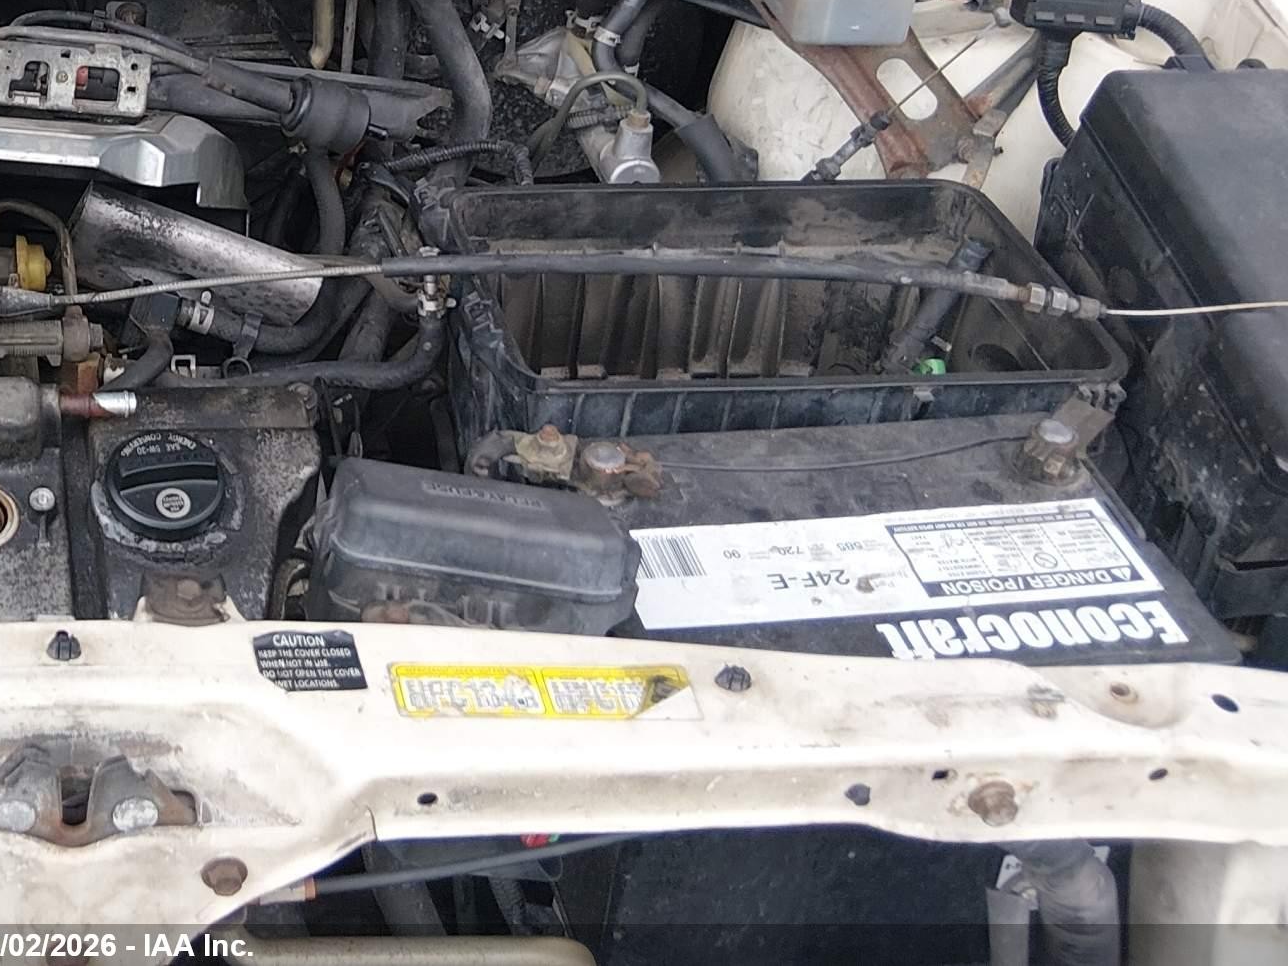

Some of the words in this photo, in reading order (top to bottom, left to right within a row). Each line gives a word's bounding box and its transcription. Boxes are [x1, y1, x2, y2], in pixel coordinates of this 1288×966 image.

[168, 434, 197, 451] ENERGY
[778, 545, 804, 556] 720
[767, 569, 850, 590] 24F-E
[1025, 570, 1112, 590] DANGER
[875, 600, 1189, 660] Econocraft
[272, 634, 325, 647] CAUTION
[278, 649, 293, 657] THE
[294, 648, 321, 657] COVER
[321, 647, 351, 657] CLOSED
[295, 668, 317, 677] OPEN
[317, 668, 333, 677] THE
[333, 667, 361, 677] COVER
